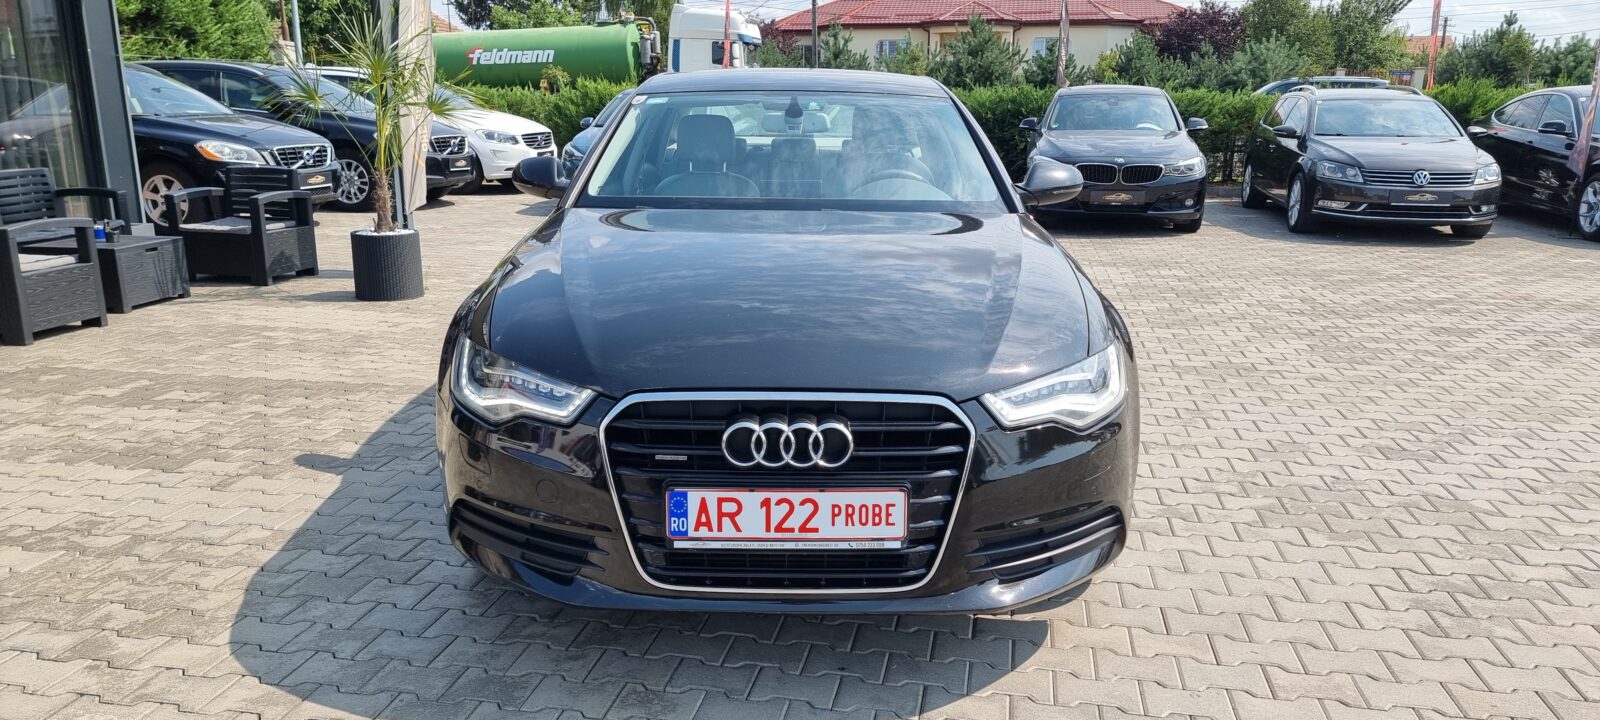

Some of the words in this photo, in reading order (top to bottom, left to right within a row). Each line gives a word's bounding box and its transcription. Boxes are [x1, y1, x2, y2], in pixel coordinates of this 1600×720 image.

[468, 48, 555, 65] feldmann
[693, 496, 743, 533] AR
[759, 497, 820, 533] 122
[831, 503, 896, 527] PROBE
[670, 516, 687, 532] RO
